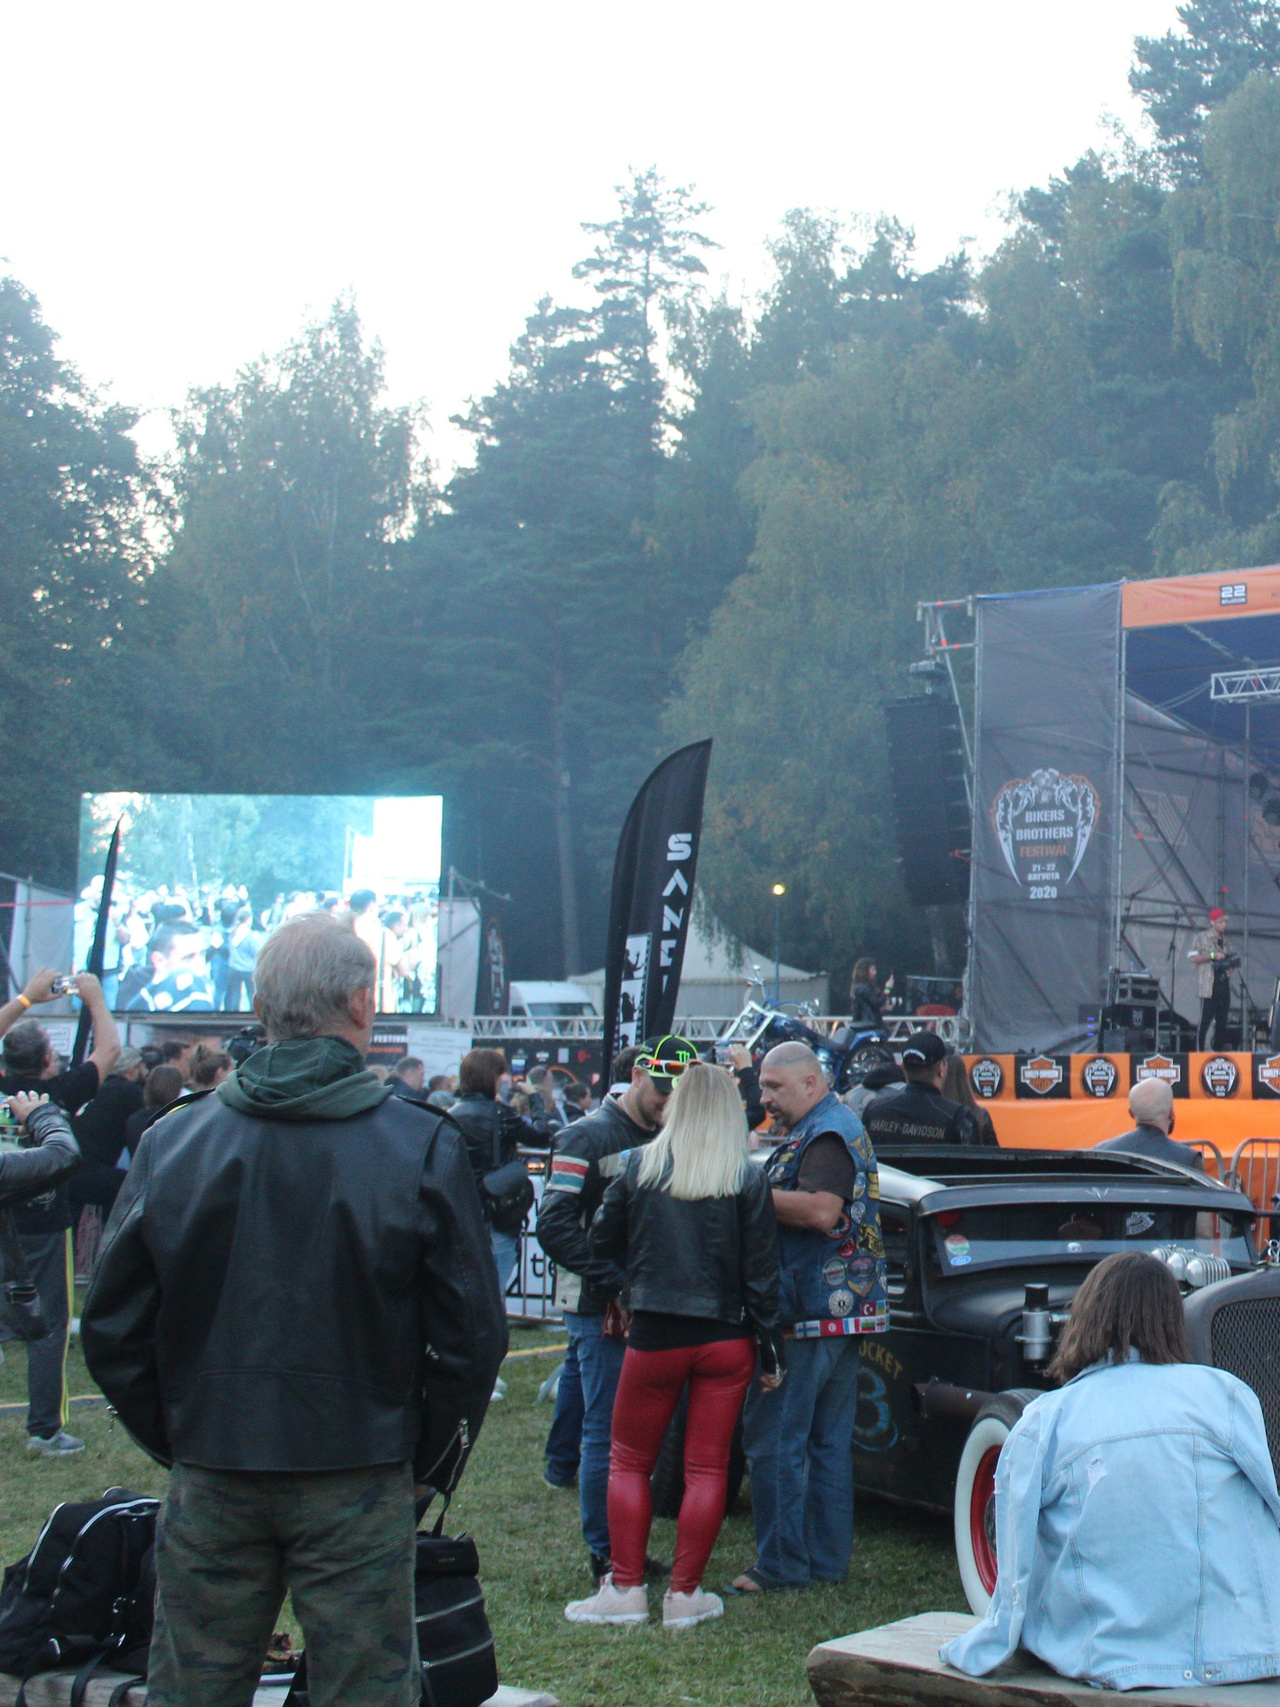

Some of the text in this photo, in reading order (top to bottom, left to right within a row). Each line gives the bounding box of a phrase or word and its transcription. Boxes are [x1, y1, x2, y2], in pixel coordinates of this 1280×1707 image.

[1221, 584, 1246, 598] 22
[1025, 809, 1065, 823] BIKERS
[1016, 826, 1074, 841] BROTHERS
[1020, 844, 1068, 858] FESTIVAL
[1027, 872, 1060, 881] АВГУСТА
[1029, 886, 1058, 900] 2020
[870, 1119, 946, 1140] HARLEY-DAVIDSON
[859, 1339, 903, 1380] UCKET
